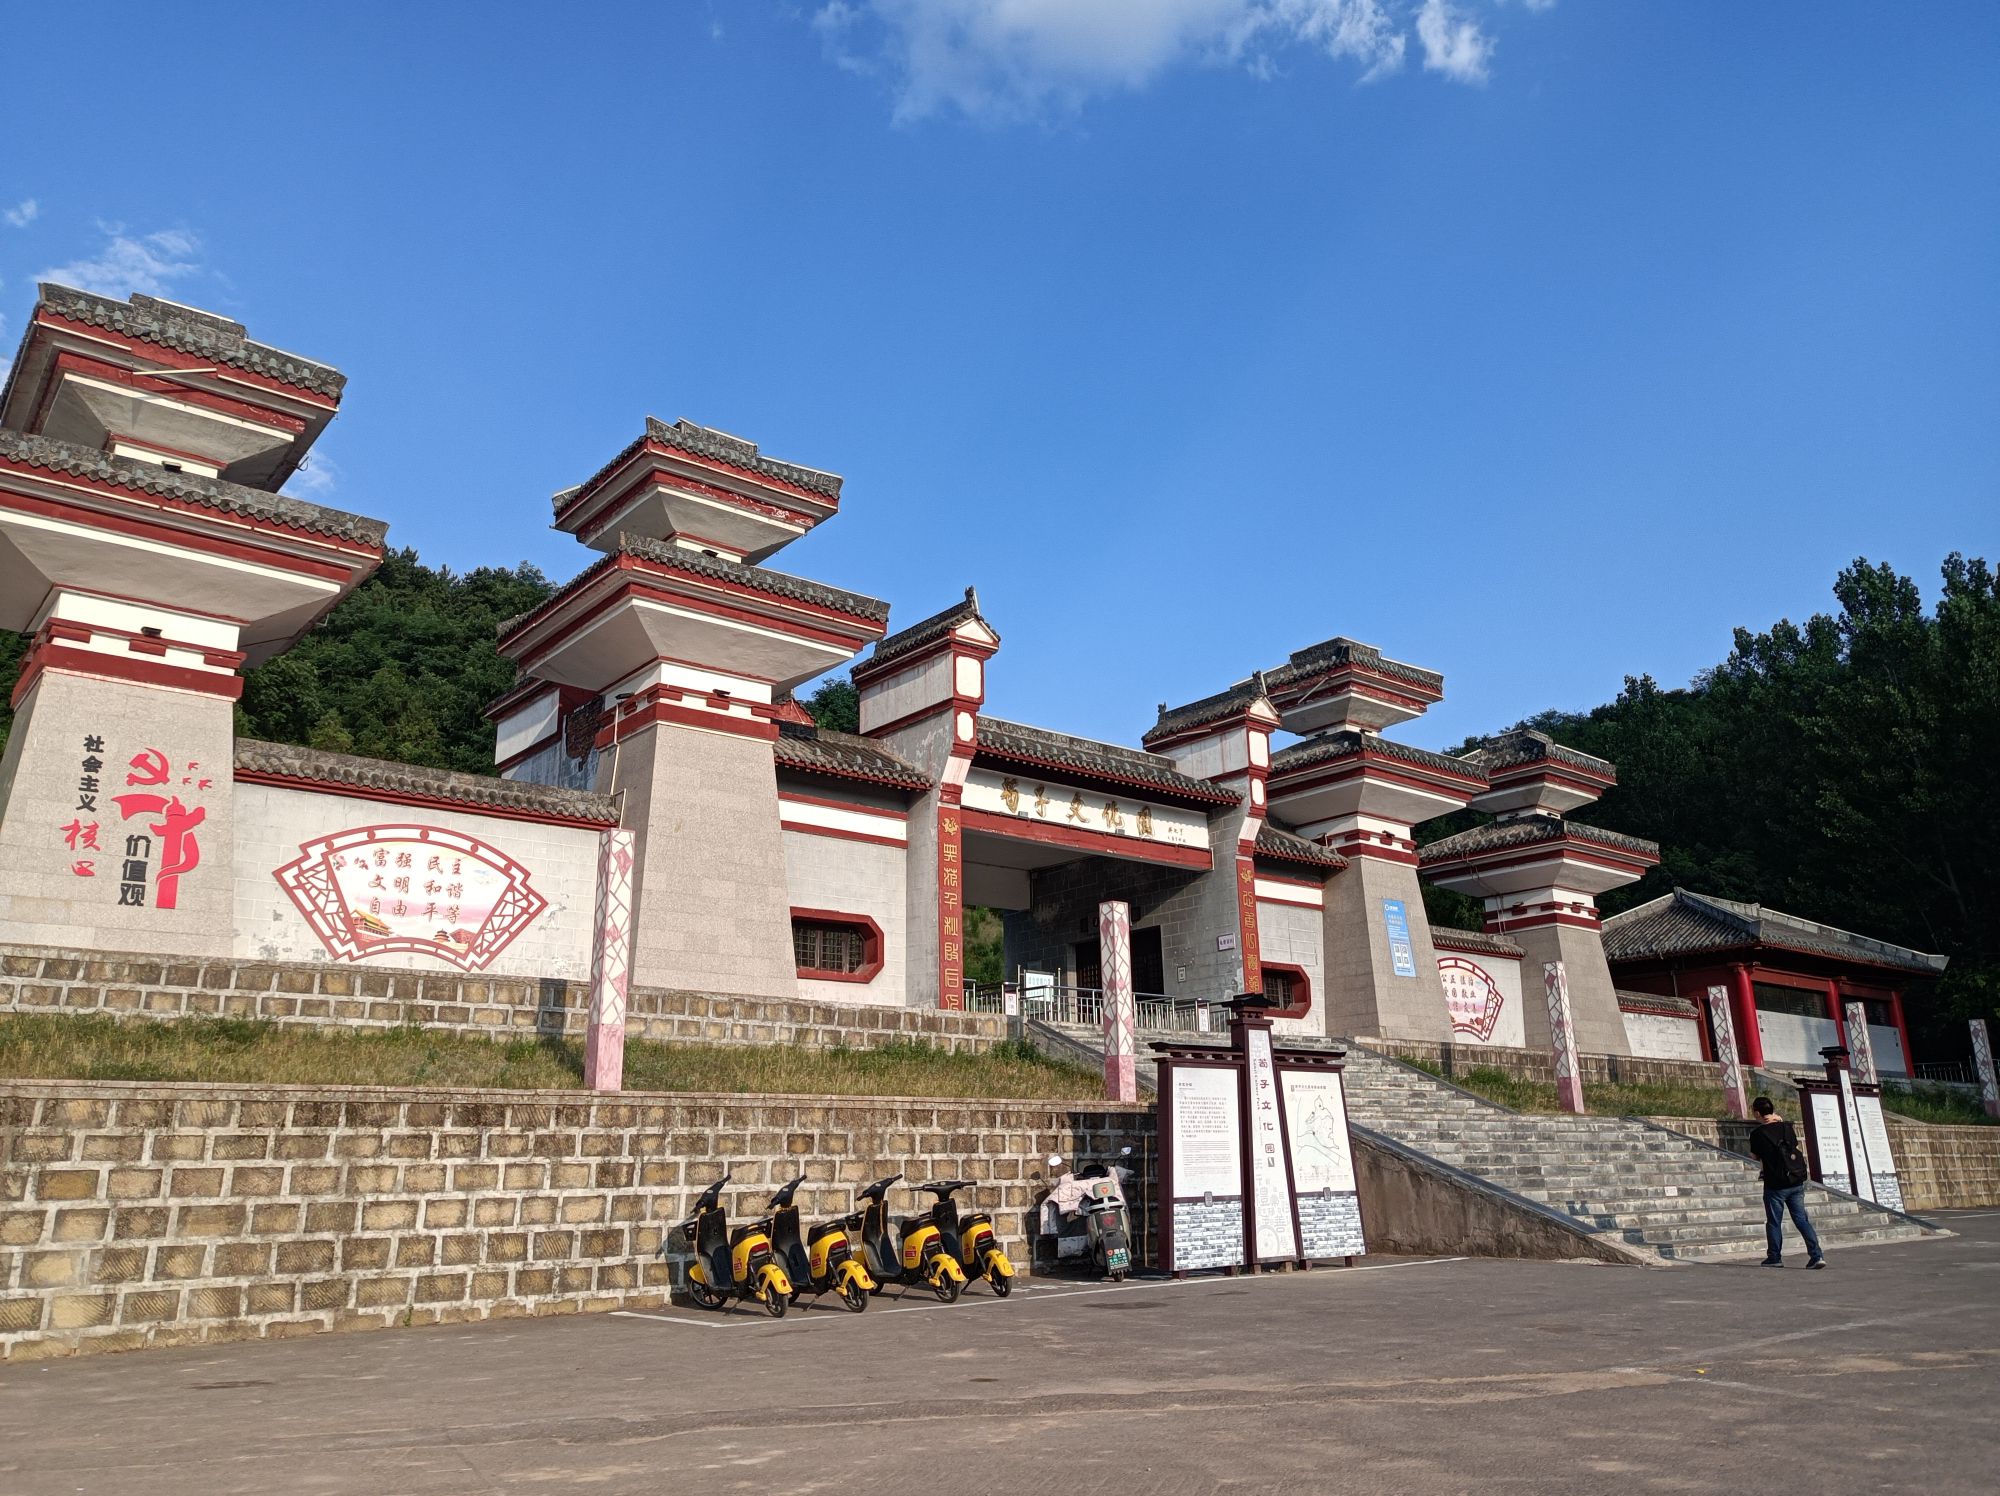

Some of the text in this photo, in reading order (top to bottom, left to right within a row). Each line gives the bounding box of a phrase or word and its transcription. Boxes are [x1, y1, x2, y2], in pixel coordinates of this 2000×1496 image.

[76, 734, 105, 812] 社会主义
[59, 819, 101, 877] 核心
[117, 834, 152, 907] 价值观
[373, 847, 462, 876] 富强 民主
[368, 874, 464, 900] 文明 和谐
[369, 897, 461, 925] 自由 平等
[1258, 1058, 1275, 1154] 荀子文化园
